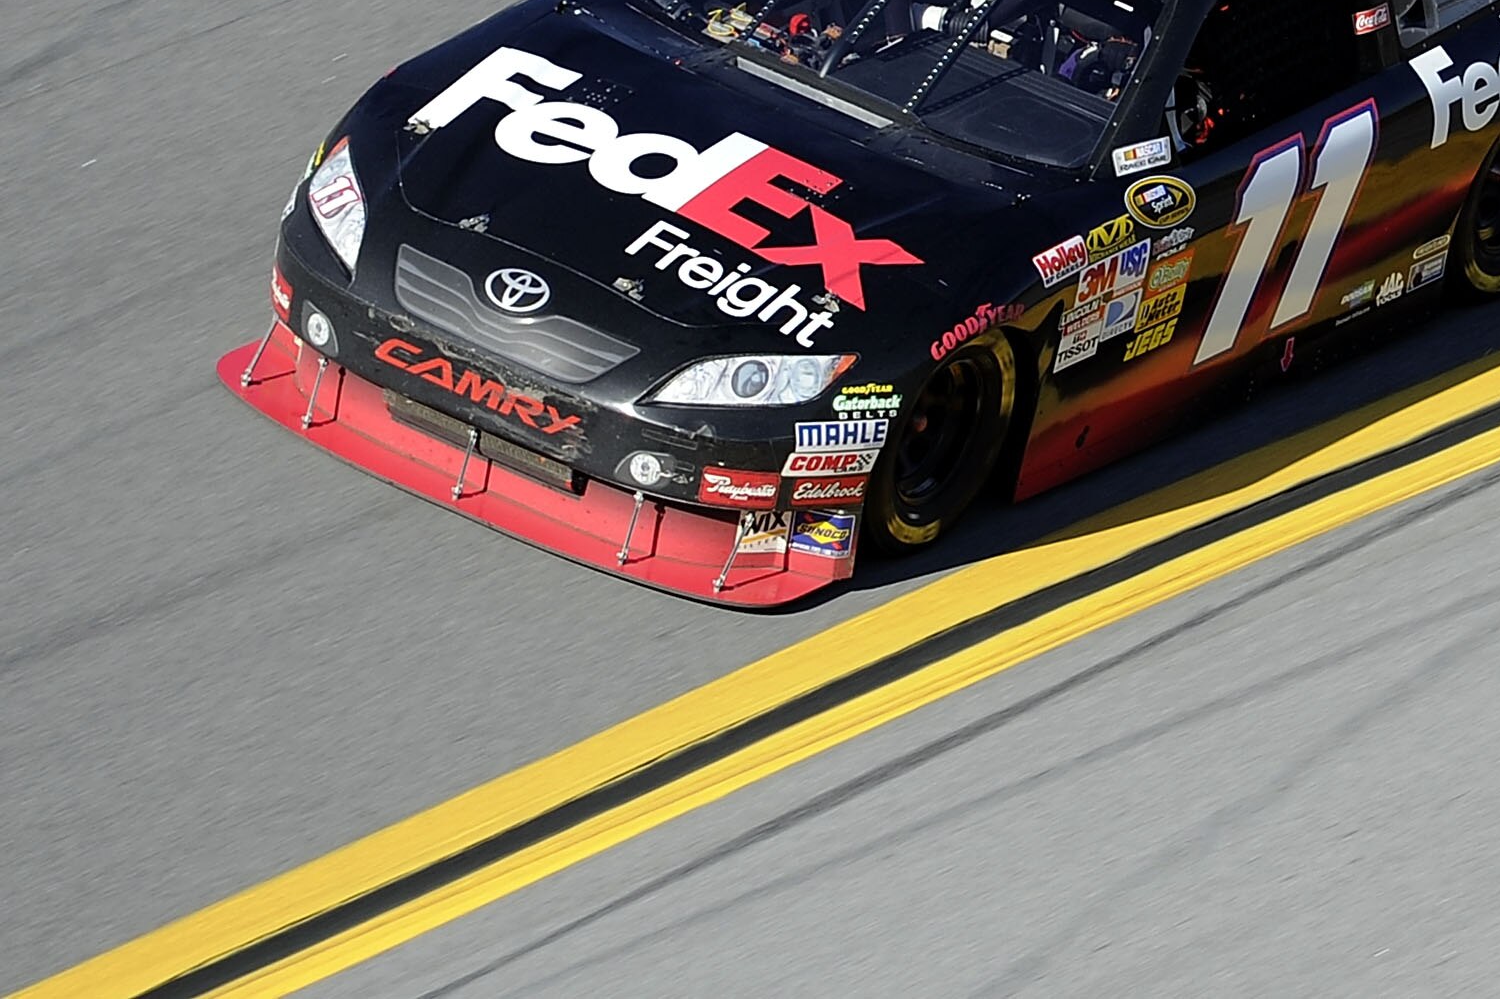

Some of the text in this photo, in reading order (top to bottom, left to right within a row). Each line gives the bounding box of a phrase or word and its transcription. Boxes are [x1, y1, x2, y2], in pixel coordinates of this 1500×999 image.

[407, 46, 926, 312] FedEx
[1188, 98, 1380, 373] 11
[1035, 241, 1087, 279] Holley
[1078, 256, 1120, 303] 3M
[1119, 241, 1148, 277] USG
[624, 220, 835, 349] Freight
[930, 302, 1025, 361] GOODYEAR
[1057, 336, 1099, 364] TISSOT
[1124, 318, 1178, 362] JEGS
[373, 337, 584, 435] CAMRY
[798, 421, 886, 447] MAHLE
[839, 409, 897, 420] BELTS
[789, 453, 858, 472] COMP
[793, 482, 866, 500] Edelbrock
